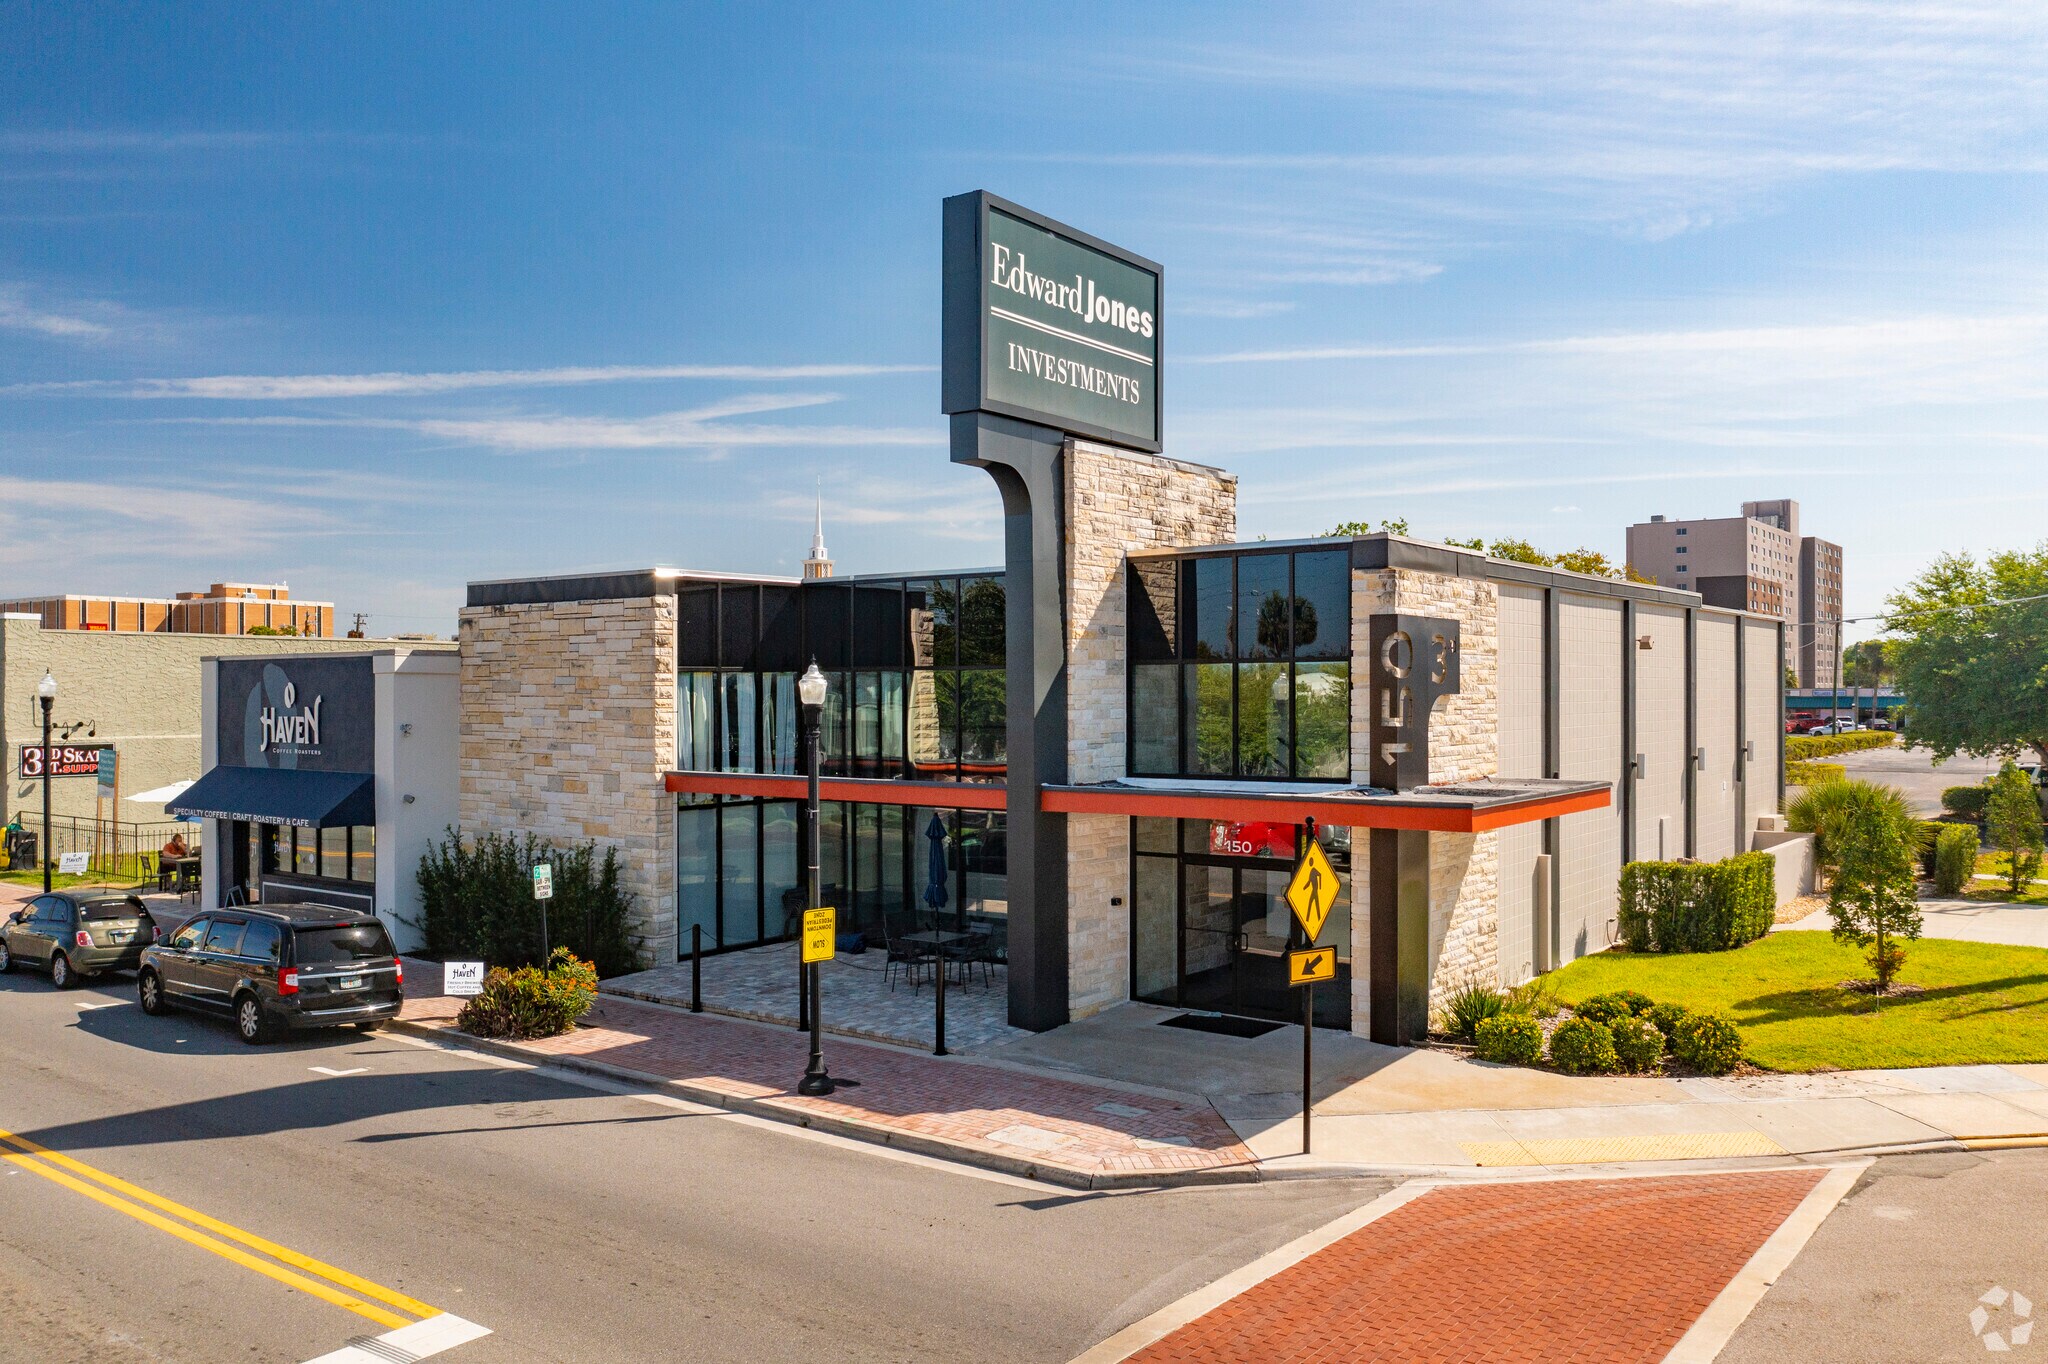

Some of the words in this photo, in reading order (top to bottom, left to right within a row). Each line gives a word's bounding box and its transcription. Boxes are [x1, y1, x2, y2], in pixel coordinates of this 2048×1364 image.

[991, 242, 1083, 315] Edward
[1084, 279, 1153, 338] Jones
[1008, 342, 1140, 405] INVESTMENTS
[1380, 631, 1413, 766] 150
[260, 694, 322, 752] HAVEN
[63, 747, 99, 763] SKAT
[62, 763, 97, 773] SUPP
[173, 807, 203, 816] SPECIALTY
[204, 810, 227, 819] COFFEE
[232, 812, 252, 821] CRAFT
[253, 814, 285, 825] ROASTERY
[286, 817, 291, 825] &
[292, 818, 309, 827] CAFE
[1224, 840, 1252, 853] 150
[807, 924, 831, 932] DOWNTOWN
[813, 939, 825, 948] SLOW
[452, 966, 476, 979] HAVEN
